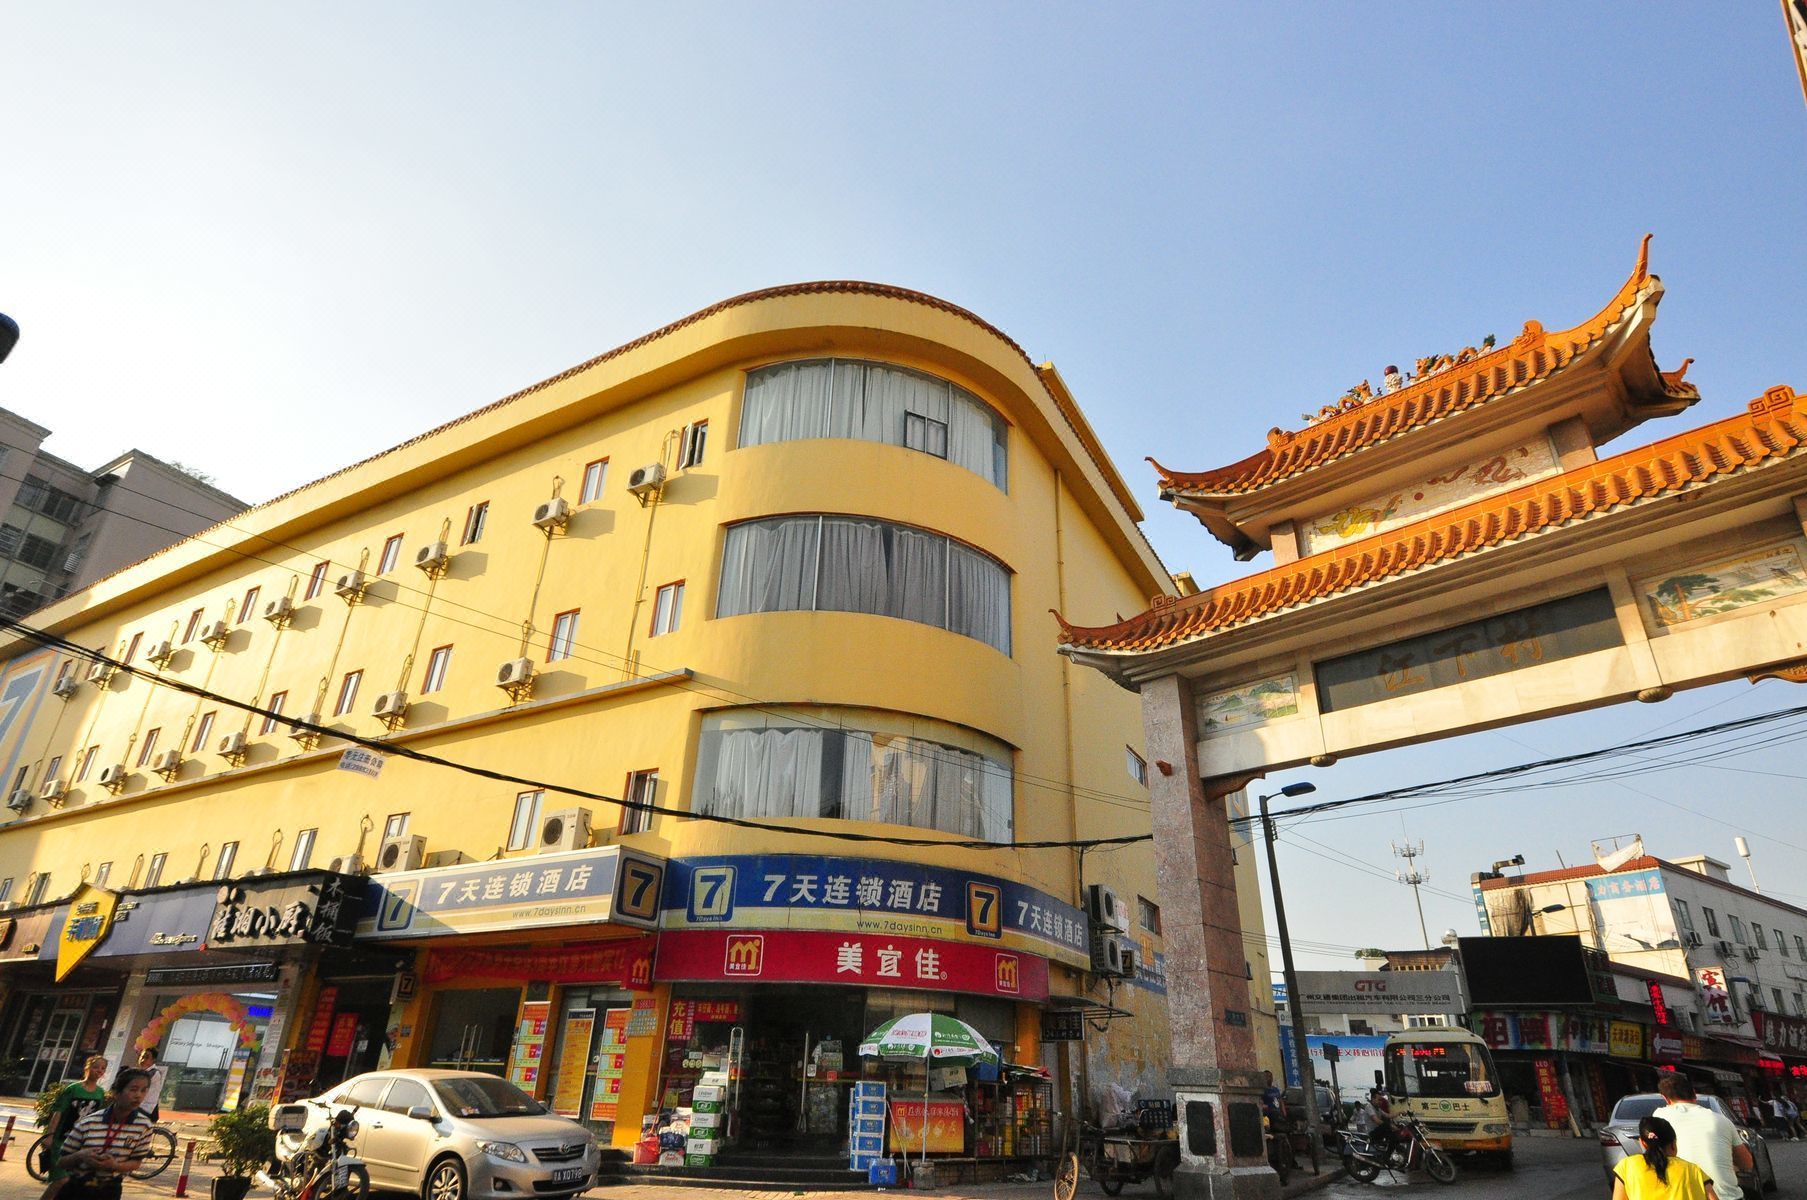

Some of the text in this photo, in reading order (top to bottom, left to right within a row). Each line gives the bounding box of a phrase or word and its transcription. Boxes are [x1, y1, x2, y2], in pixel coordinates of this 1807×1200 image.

[437, 864, 593, 905] 7天连锁酒店
[630, 869, 656, 907] 7
[699, 874, 724, 909] 7
[763, 874, 942, 913] 7天连锁酒店
[313, 877, 344, 943] 木桶饭
[389, 884, 416, 921] 7
[512, 904, 587, 920] www.7daysinn.cn
[974, 890, 995, 924] 7
[856, 919, 943, 934] www.7daysinn.cn
[1017, 900, 1083, 948] 7天连锁酒店
[836, 941, 941, 980] 美宜佳
[1354, 979, 1386, 992] GTG
[670, 1001, 687, 1036] 充值
[1310, 1048, 1385, 1056] 行主义核心价值
[1422, 1102, 1470, 1111] 第二 巴士
